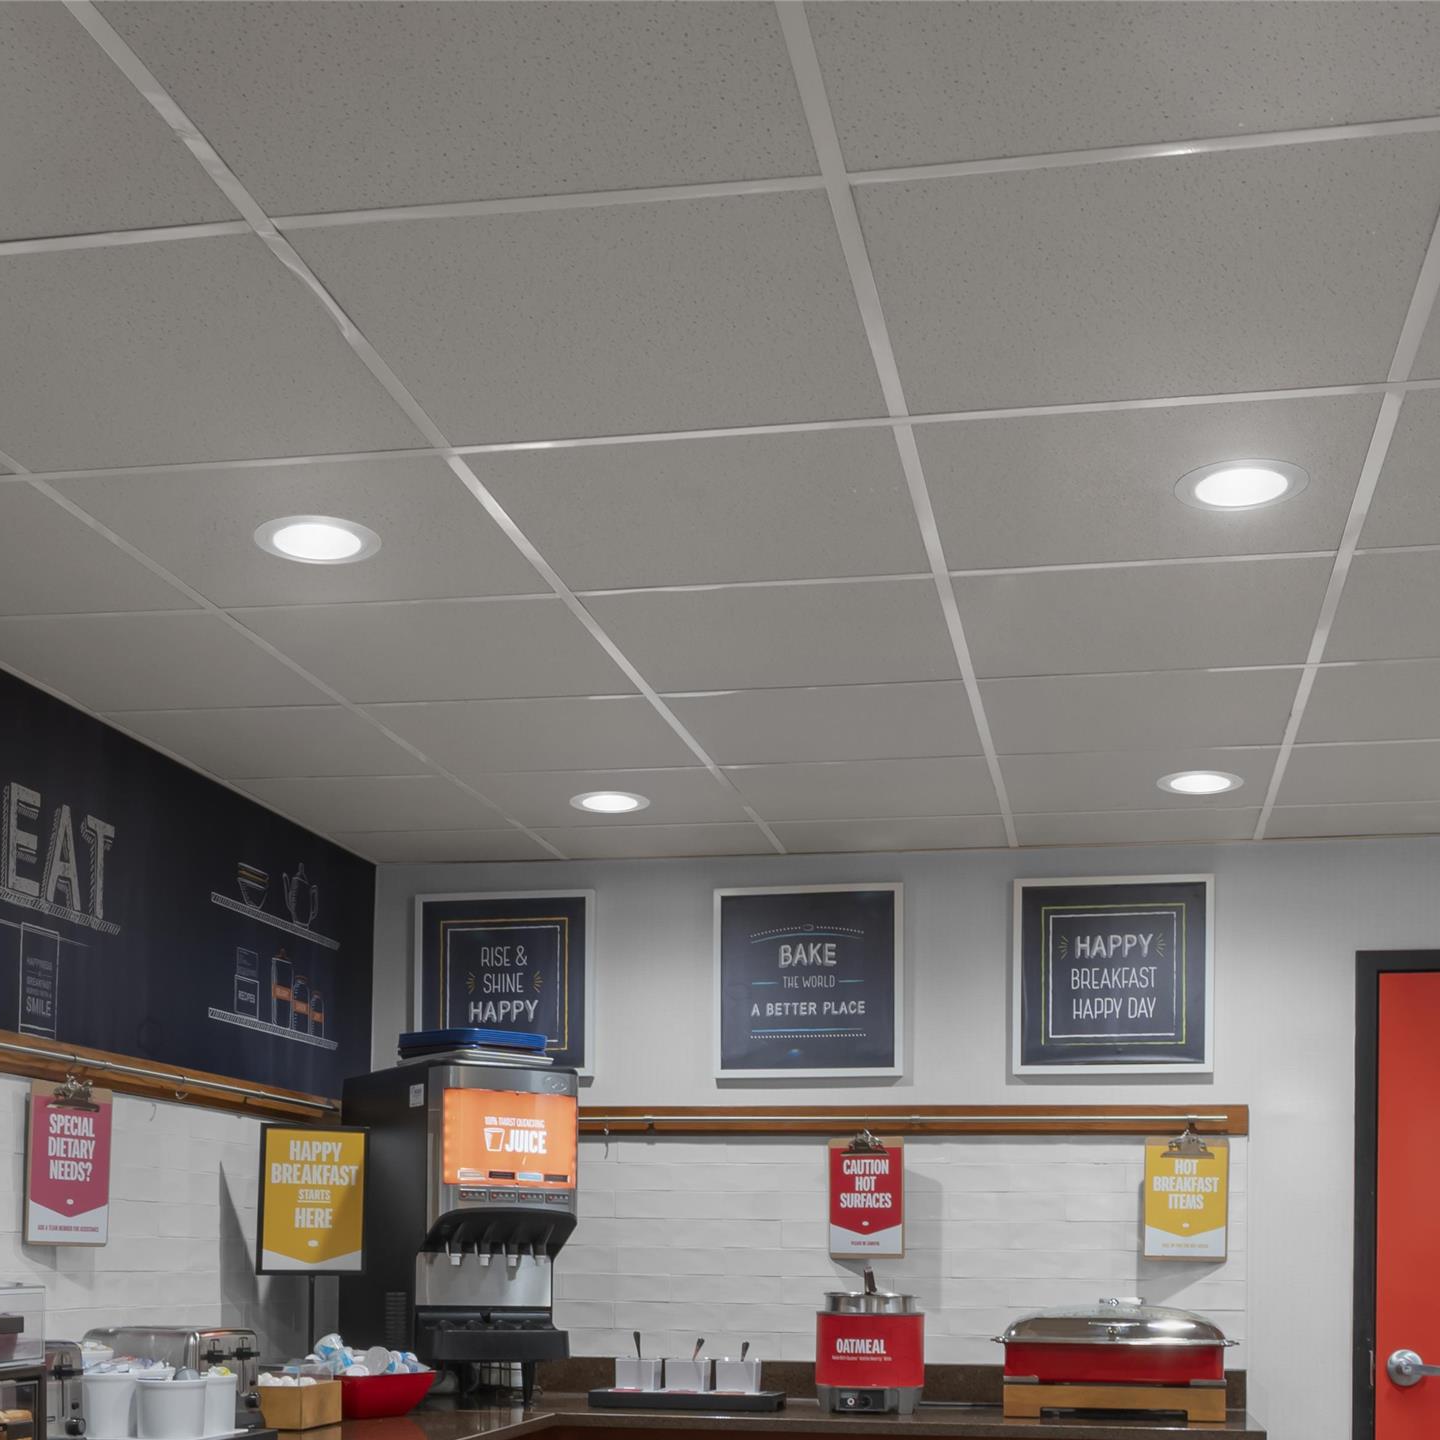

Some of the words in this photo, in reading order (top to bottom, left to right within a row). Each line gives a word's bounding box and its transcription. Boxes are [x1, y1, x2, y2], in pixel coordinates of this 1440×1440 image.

[1, 781, 116, 921] EAT
[481, 947, 511, 967] RISE
[515, 945, 528, 966] &
[778, 943, 838, 969] BAKE
[1074, 934, 1154, 959] HAPPY
[483, 972, 524, 994] SHINE
[783, 976, 799, 989] THE
[802, 975, 836, 988] WORLD
[1071, 967, 1158, 990] BREAKFAST
[26, 996, 52, 1017] SMILE
[468, 1000, 539, 1024] HAPPY
[751, 1003, 761, 1017] A
[766, 1002, 817, 1016] BETTER
[823, 1001, 866, 1015] PLACE
[1073, 998, 1122, 1019] HAPPY
[1127, 997, 1156, 1018] DAY
[49, 1113, 95, 1137] SPECIAL
[47, 1136, 96, 1159] DIETARY
[289, 1140, 342, 1162] HAPPY
[505, 1129, 547, 1154] JUICE
[49, 1159, 93, 1182] NEEDS?
[271, 1163, 359, 1186] BREAKFAST
[843, 1159, 889, 1175] CAUTION
[1174, 1159, 1198, 1175] HOT
[298, 1189, 331, 1200] STARTS
[855, 1176, 876, 1191] HOT
[1152, 1177, 1220, 1192] BREAKFAST
[840, 1193, 892, 1208] SURFACES
[1167, 1194, 1204, 1209] ITEMS
[294, 1207, 333, 1229] HERE
[836, 1338, 887, 1354] OATMEAL
